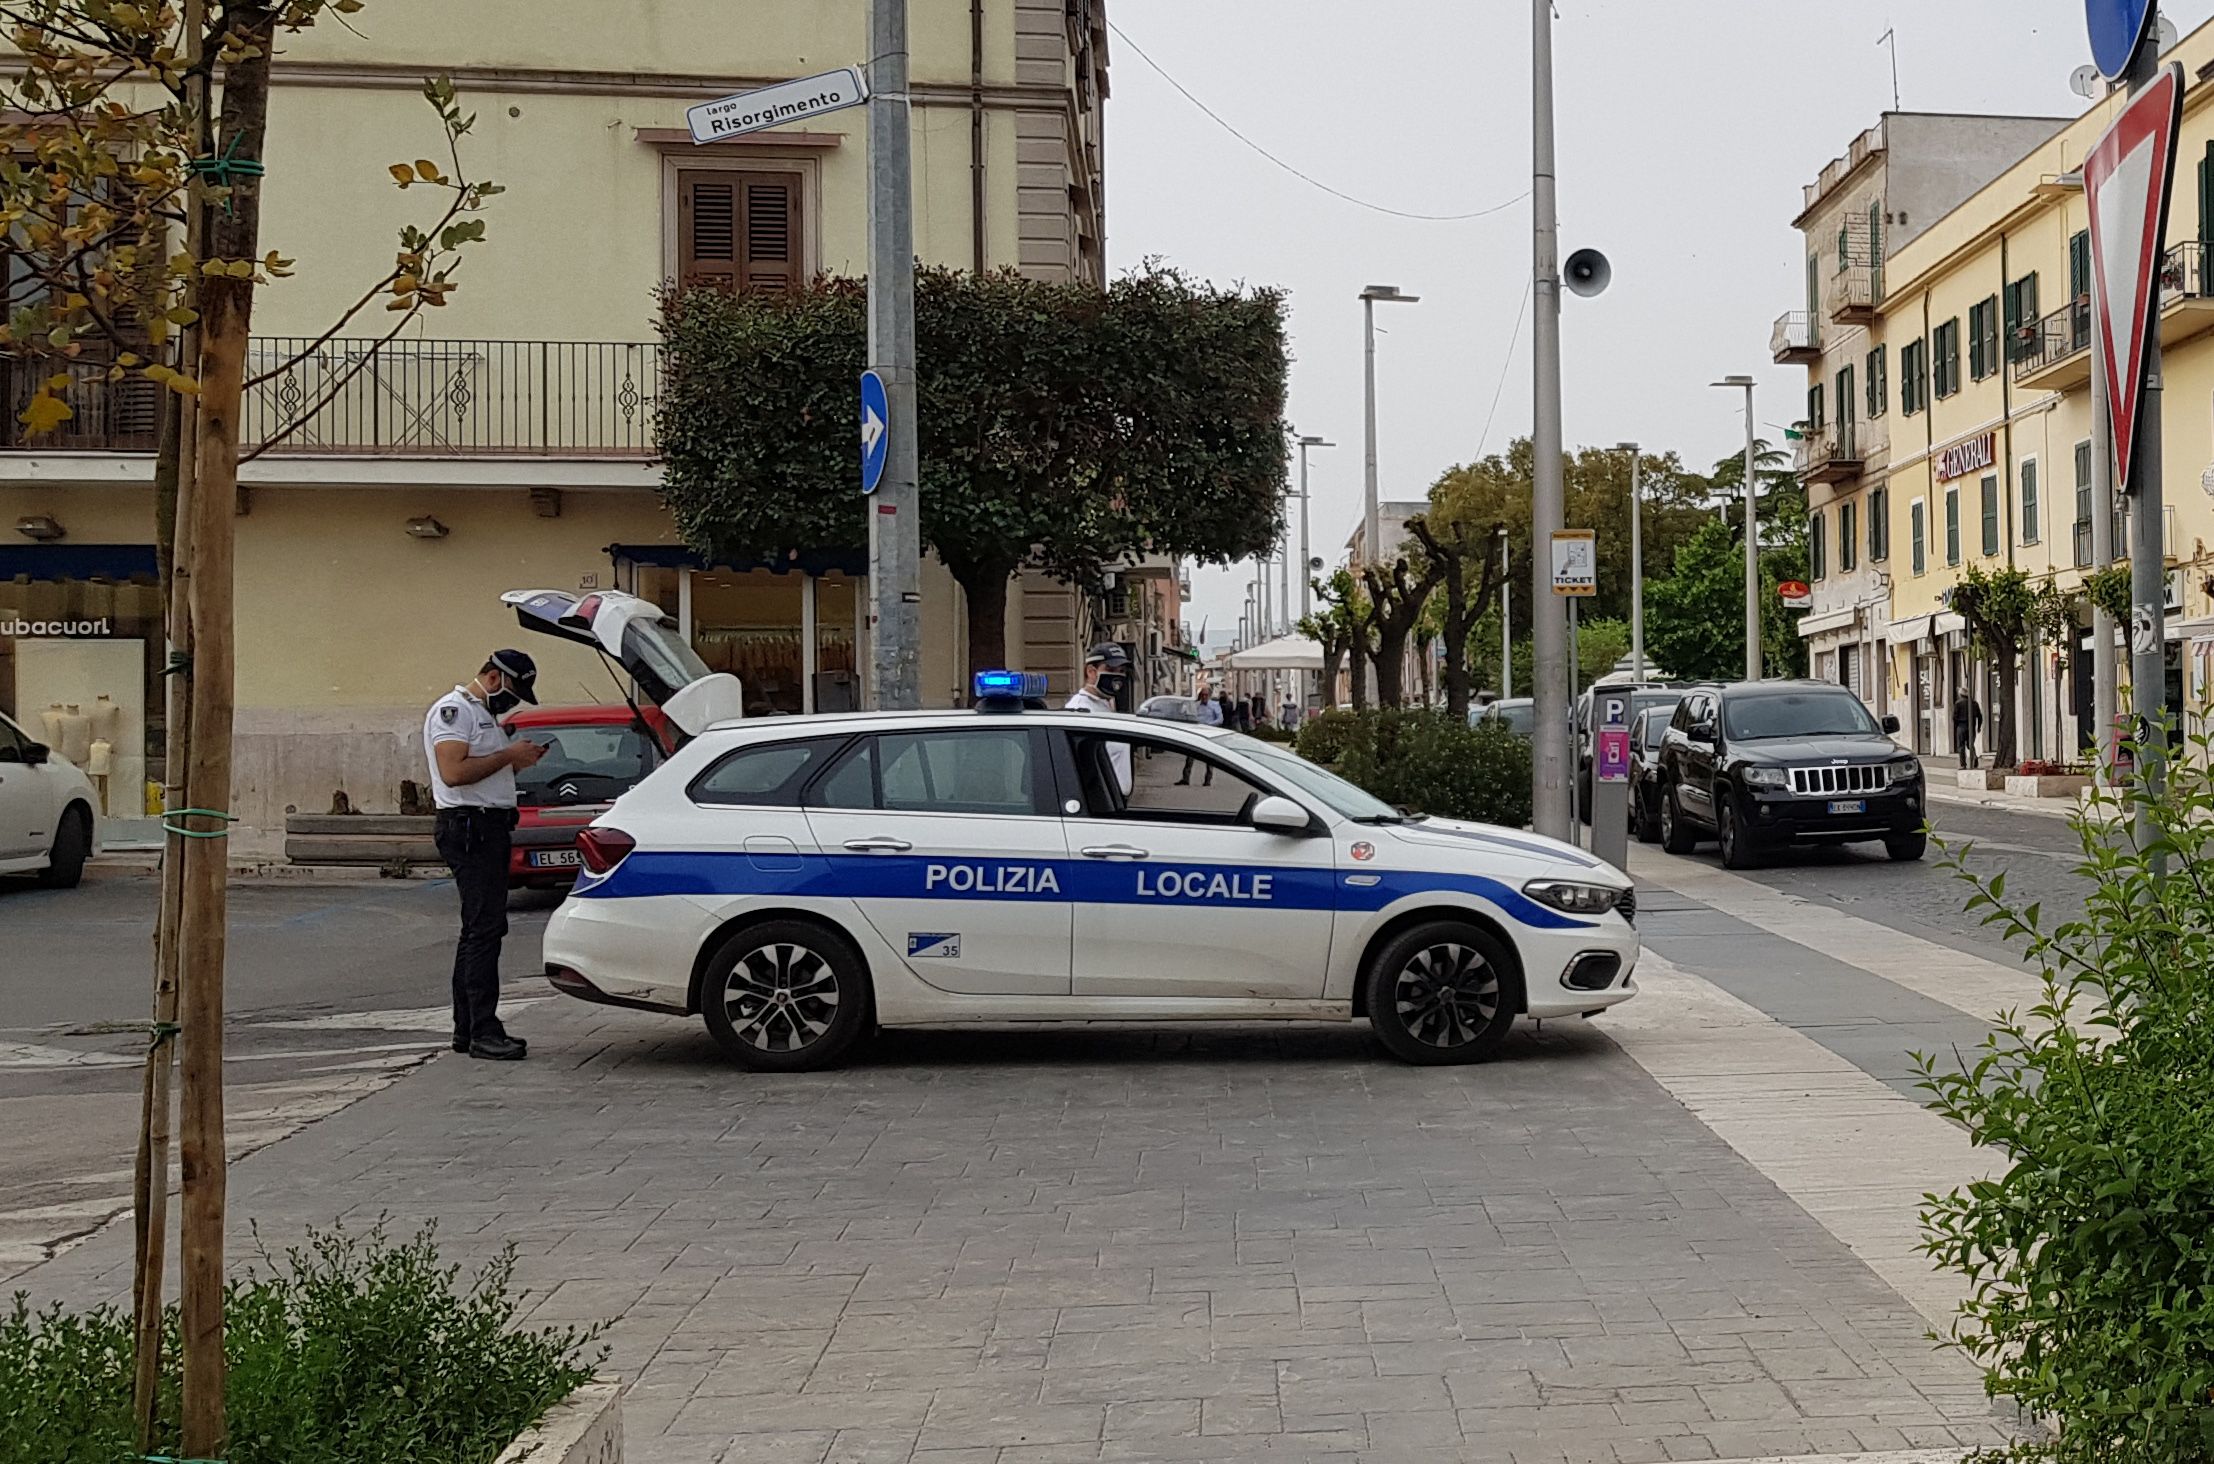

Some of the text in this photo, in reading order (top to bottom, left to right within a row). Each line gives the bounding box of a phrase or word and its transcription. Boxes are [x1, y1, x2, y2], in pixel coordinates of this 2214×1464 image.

[706, 102, 737, 116] largo
[711, 92, 841, 133] Risorgimento
[1946, 432, 1992, 478] GENERALI
[1554, 576, 1592, 584] TICKET
[539, 853, 556, 865] EL
[925, 864, 1273, 900] POLIZIA LOCALE
[943, 945, 958, 956] 35
